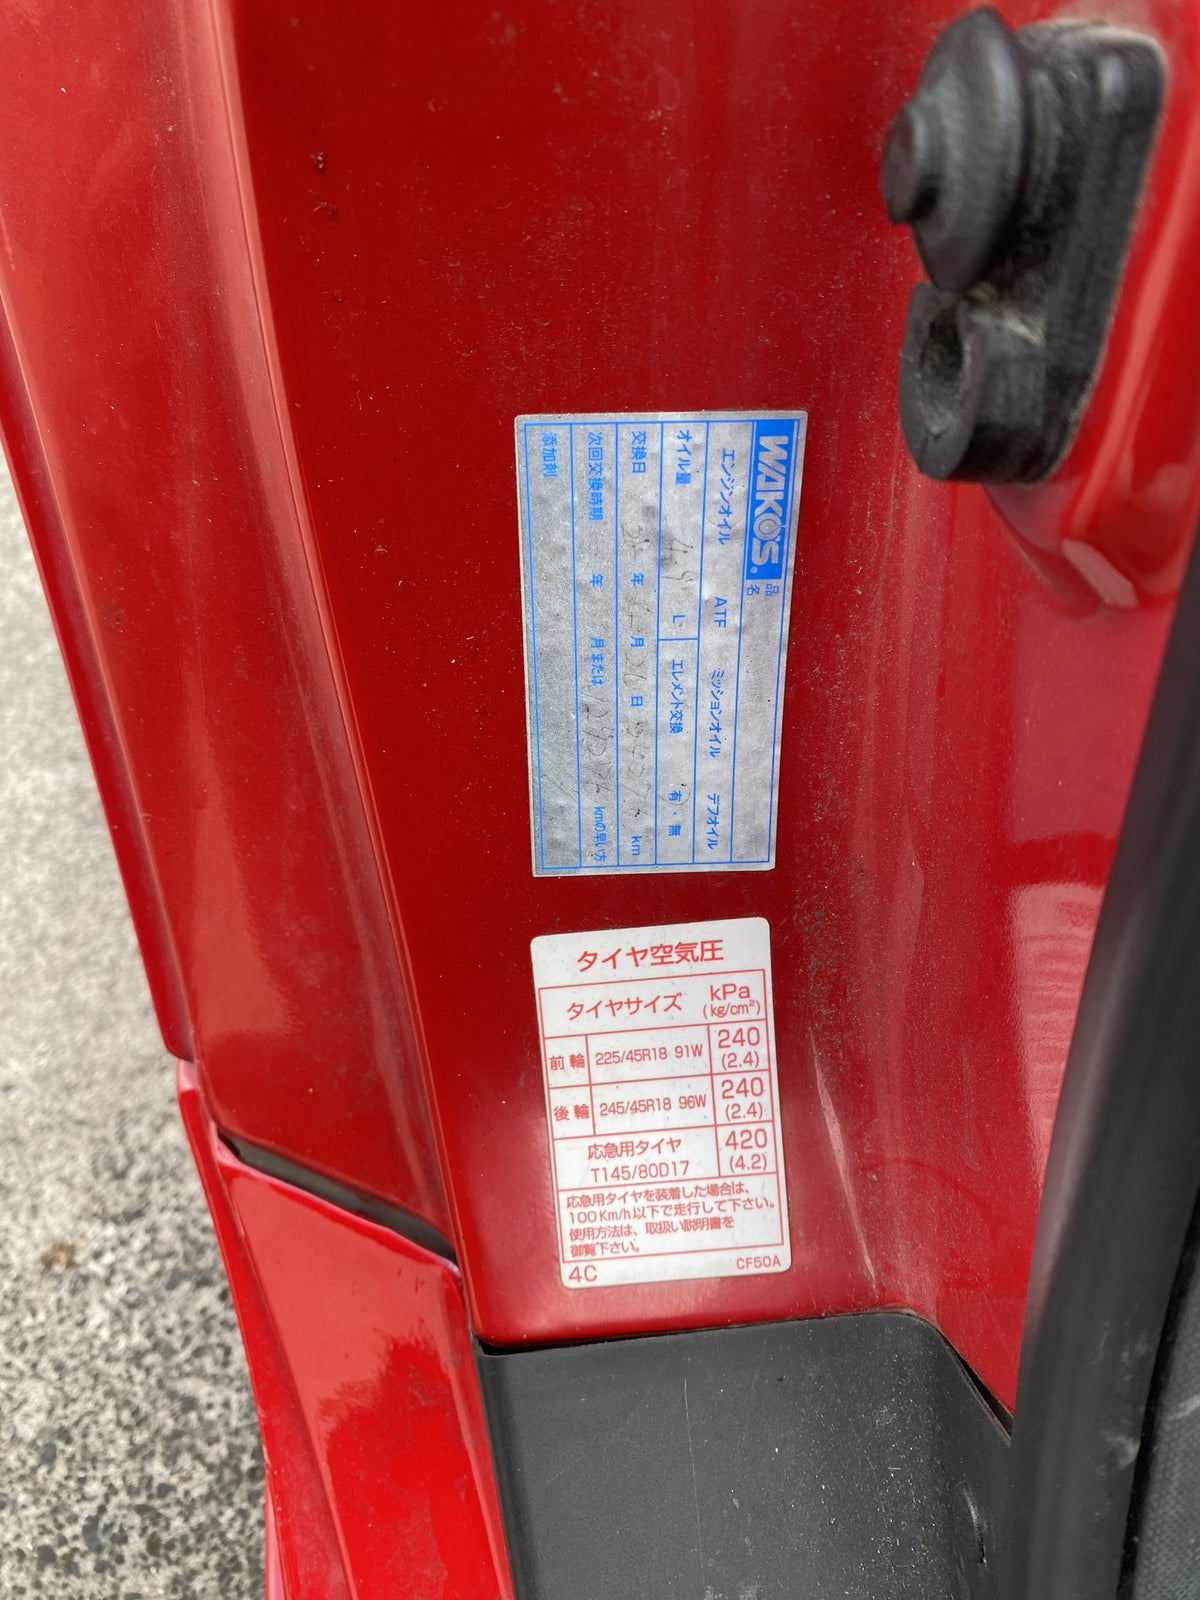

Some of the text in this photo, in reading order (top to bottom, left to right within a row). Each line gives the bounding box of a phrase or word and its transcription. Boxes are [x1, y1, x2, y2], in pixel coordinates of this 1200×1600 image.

[540, 430, 559, 478] 添加剤
[631, 429, 648, 474] 交換日
[675, 429, 693, 486] オイル量
[586, 431, 605, 521] 次回交換時期
[717, 448, 736, 545] エンジンオイル
[589, 573, 604, 587] 年
[630, 572, 645, 586] 年
[672, 614, 686, 623] L
[713, 596, 728, 627] ATF
[629, 636, 645, 648] 月
[630, 694, 644, 707] 日
[669, 659, 684, 734] エレメント交換
[708, 670, 725, 758] ミッションオイル
[593, 805, 608, 862] kmの早い方
[706, 794, 720, 850] デフオイル
[631, 835, 642, 856] km
[577, 939, 724, 972] タイヤ空気圧
[709, 983, 751, 1002] kPa
[567, 992, 682, 1020] タイヤサイズ
[717, 1026, 761, 1049] 240
[595, 1043, 704, 1066] 225/45R18 91W
[720, 1050, 760, 1070] (2.4)
[720, 1076, 765, 1099] 240
[599, 1094, 707, 1117] 245/45R18 96W
[725, 1102, 764, 1121] (2.4)
[587, 1137, 682, 1160] 応急用タイヤ
[725, 1128, 769, 1151] 420
[590, 1160, 690, 1184] T145/80D17
[729, 1153, 768, 1174] (4.2)
[566, 1181, 750, 1209] 応急用タイヤを装着した場合は、
[569, 1216, 735, 1242] 使用方法は、取扱い説明書を
[570, 1239, 641, 1259] 御覧下さい。
[568, 1264, 598, 1283] 4C
[736, 1255, 782, 1270] CF50A
